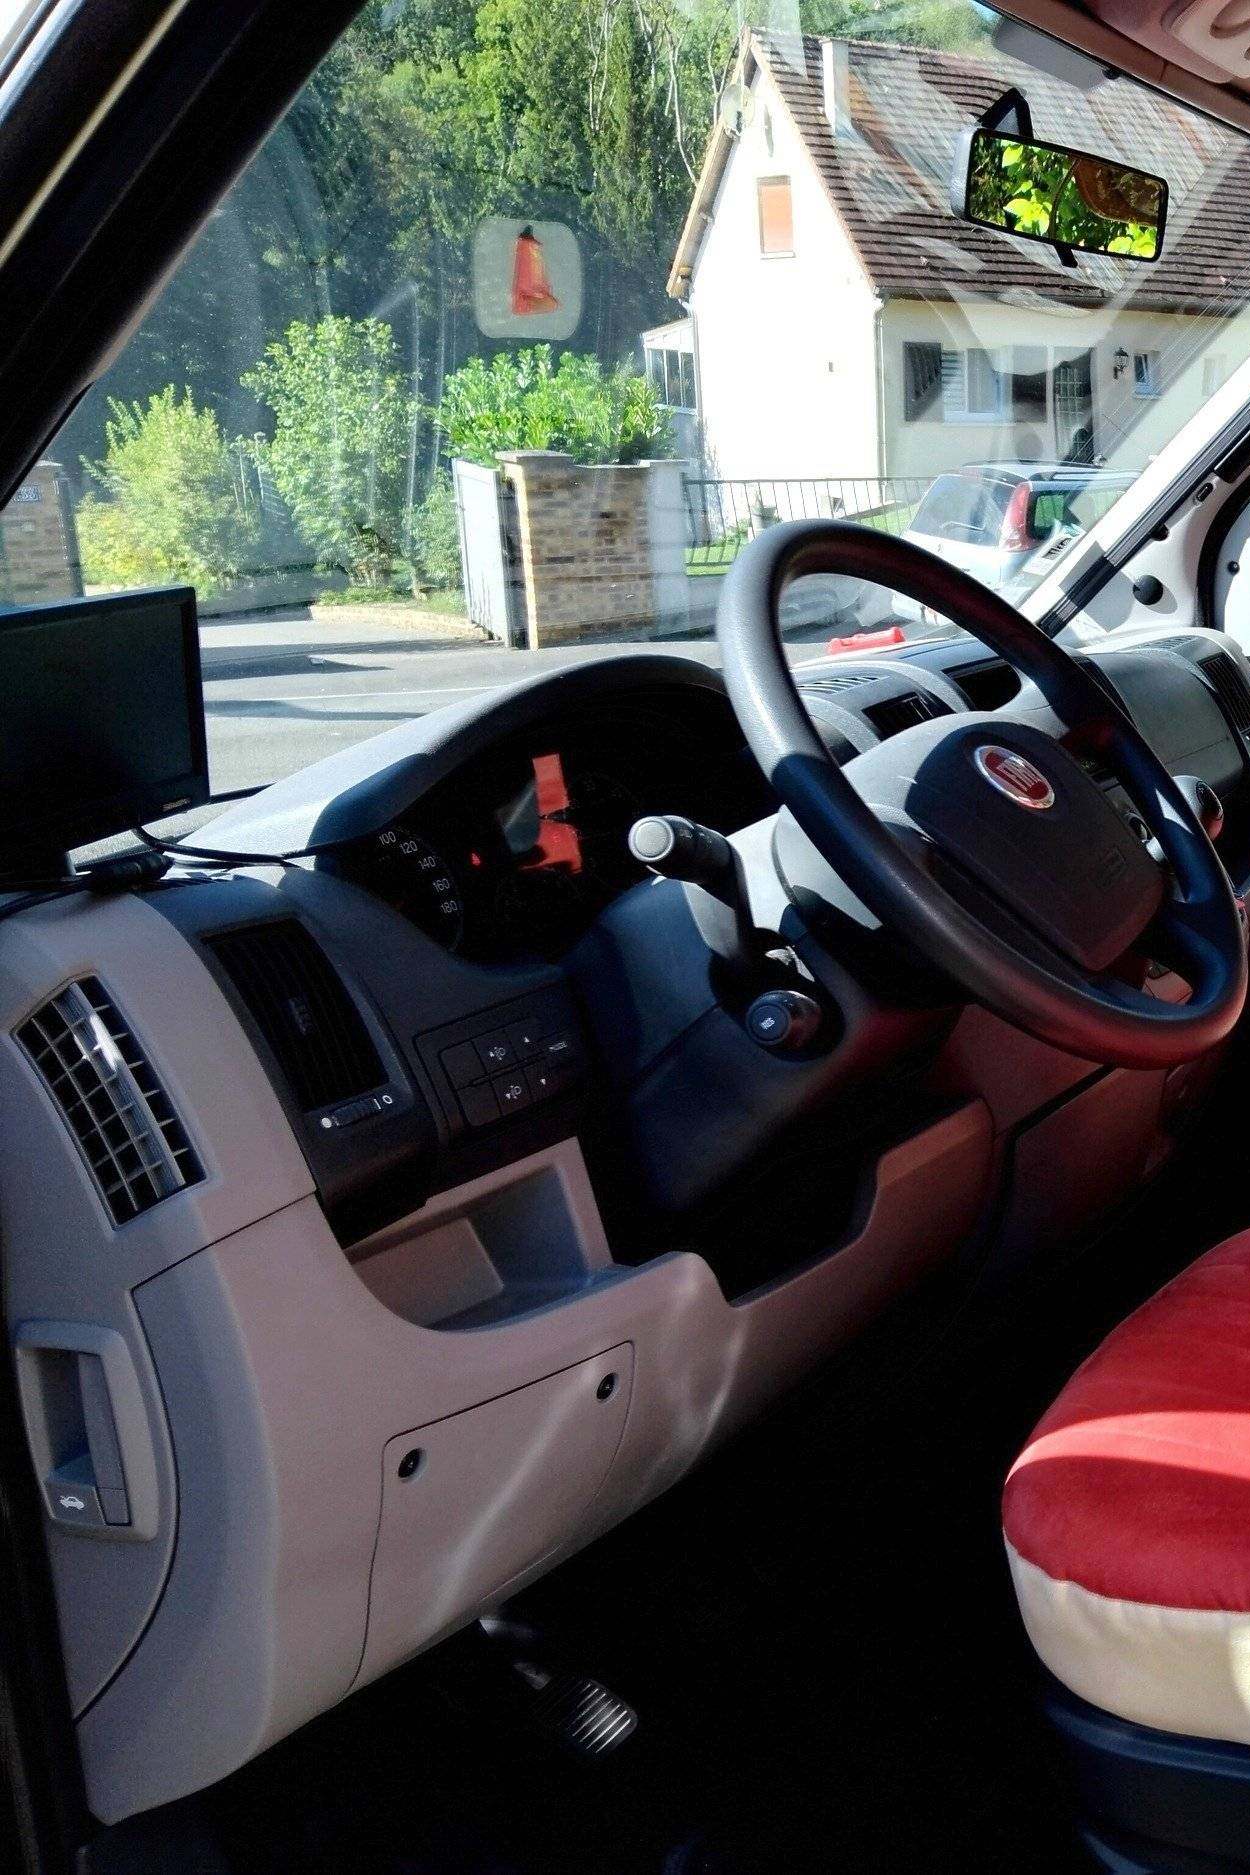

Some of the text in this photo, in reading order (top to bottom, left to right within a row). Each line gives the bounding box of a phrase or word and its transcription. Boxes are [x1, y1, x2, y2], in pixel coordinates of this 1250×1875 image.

[379, 831, 397, 846] 100
[400, 840, 418, 854] 120
[418, 856, 436, 869] 140
[432, 878, 450, 892] 160
[441, 900, 458, 914] 180
